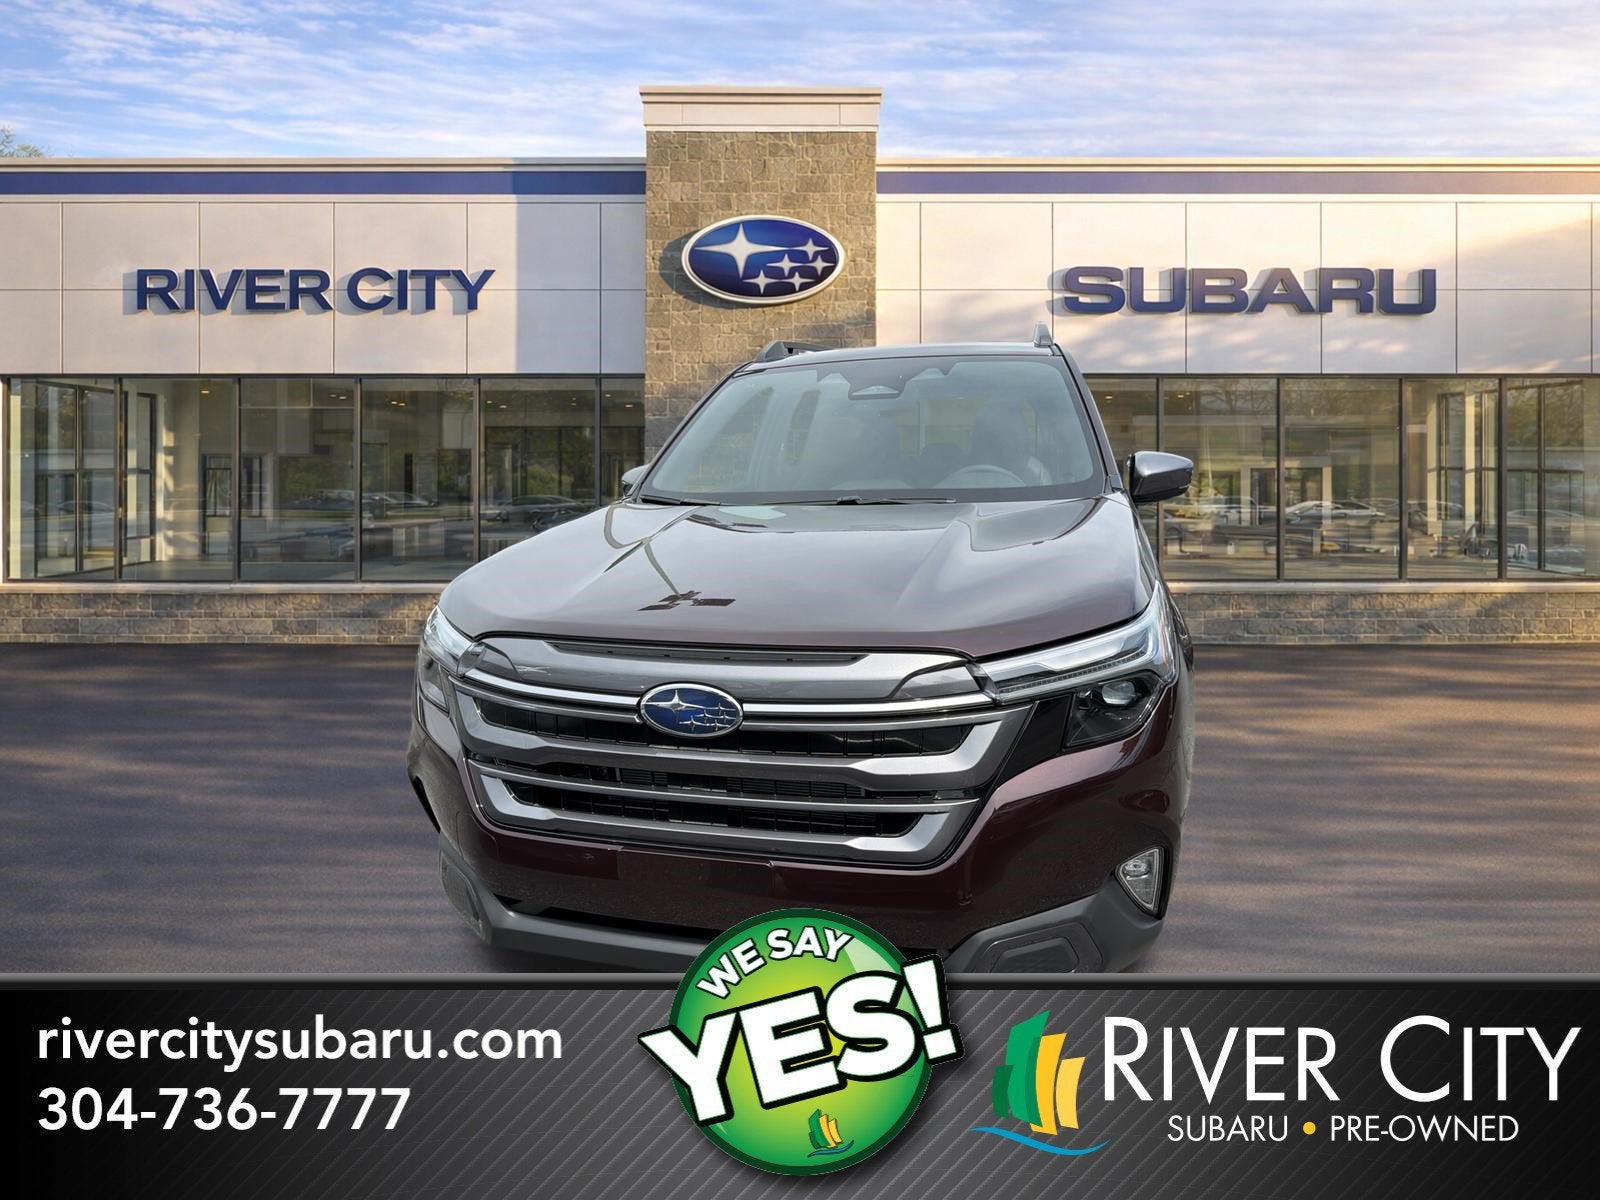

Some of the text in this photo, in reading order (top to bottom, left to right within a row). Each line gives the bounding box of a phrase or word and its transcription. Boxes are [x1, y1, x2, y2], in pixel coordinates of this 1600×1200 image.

[136, 268, 496, 311] RIVER CITY
[1063, 266, 1437, 315] SUBARU
